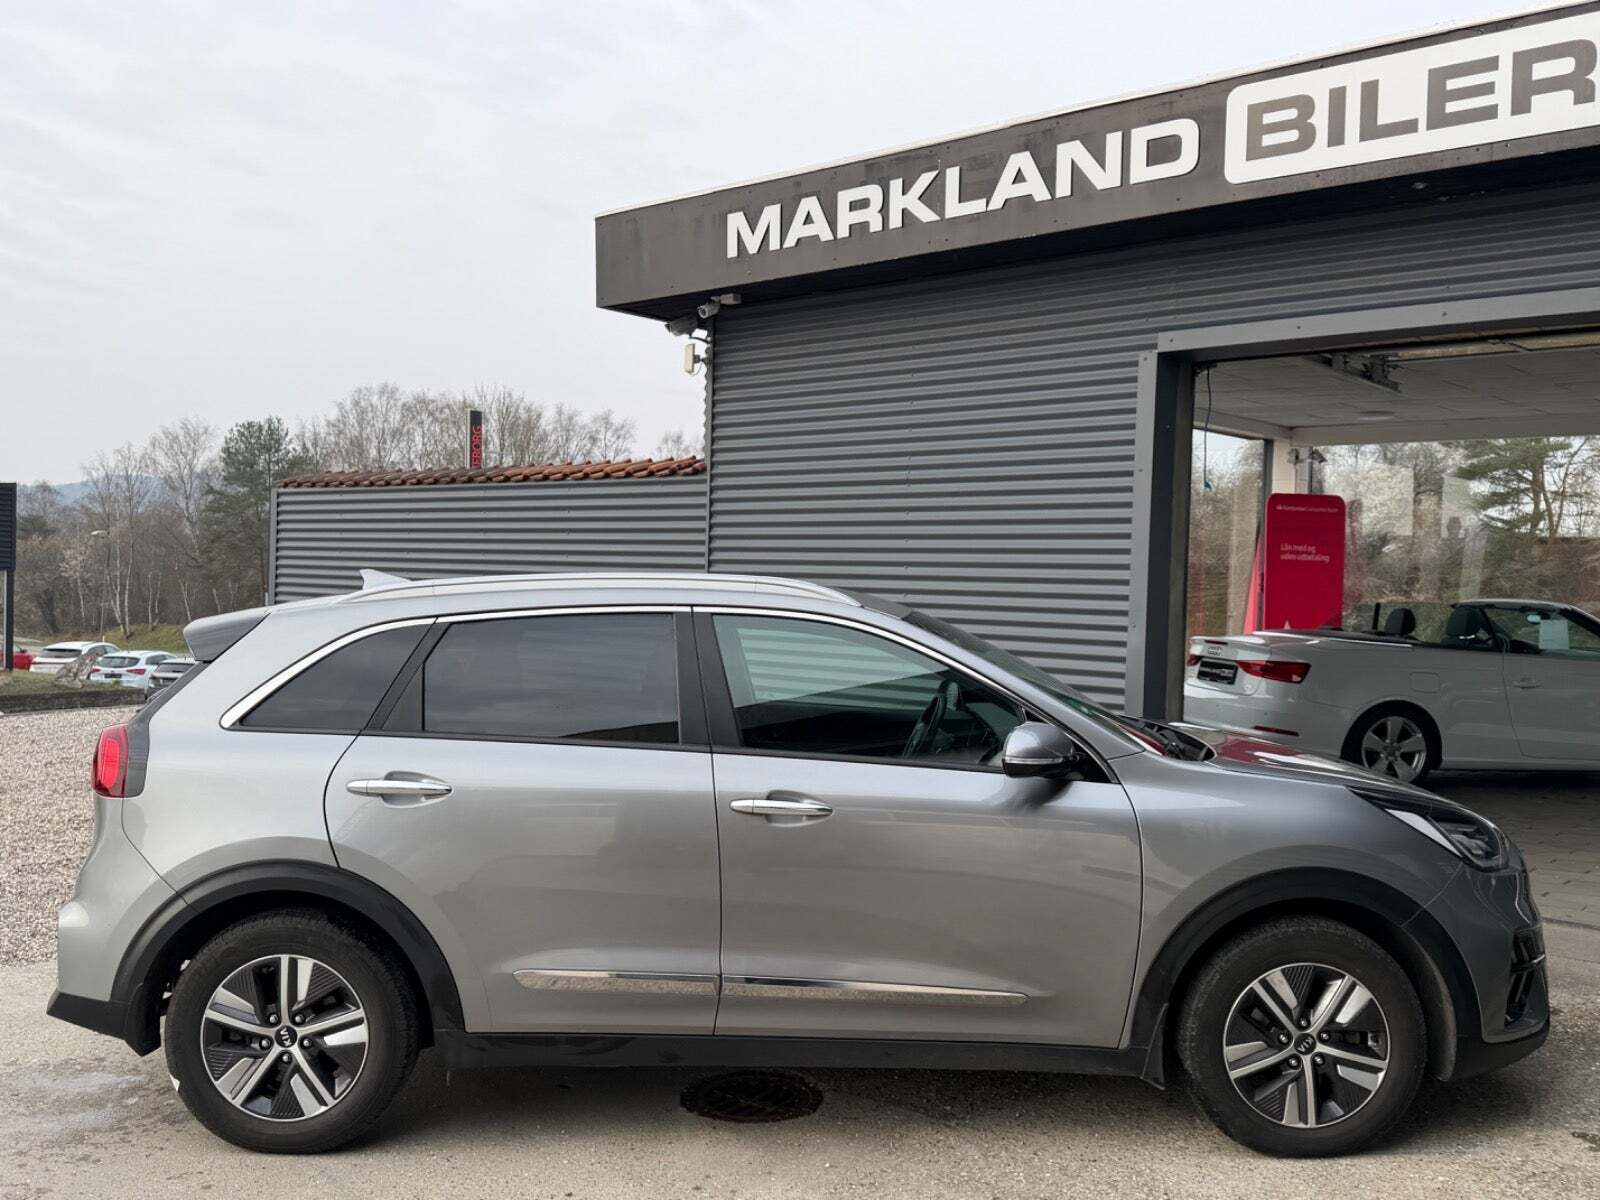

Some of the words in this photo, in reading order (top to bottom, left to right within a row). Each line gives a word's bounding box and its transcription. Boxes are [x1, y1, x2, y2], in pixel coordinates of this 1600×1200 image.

[725, 118, 1200, 259] MARKLAND
[1246, 38, 1598, 162] BILER
[280, 1027, 292, 1047] KIA
